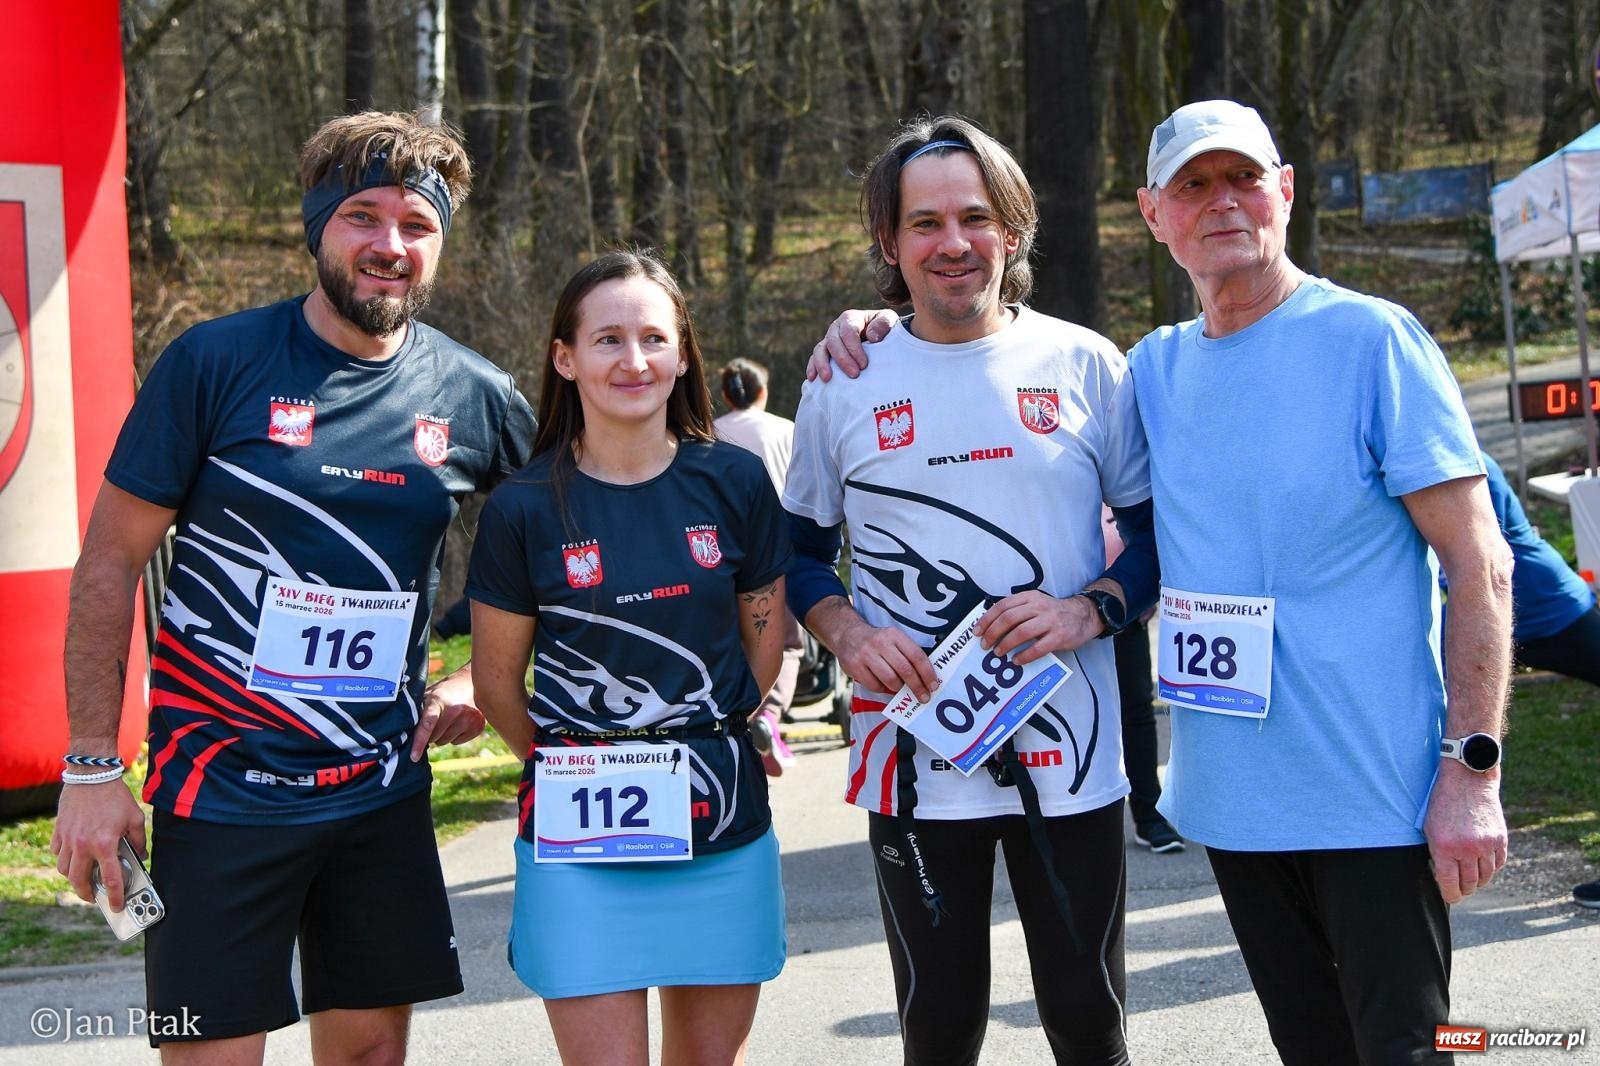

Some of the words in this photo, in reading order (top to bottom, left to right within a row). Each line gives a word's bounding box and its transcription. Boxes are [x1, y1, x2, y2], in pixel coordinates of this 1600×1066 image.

[270, 396, 315, 407] POLSKA
[873, 398, 912, 413] POLSKA
[561, 538, 598, 550] POLSKA
[277, 586, 301, 600] XIV
[305, 591, 336, 607] BIEG
[341, 596, 406, 610] TWARDZIELA
[1175, 597, 1191, 612] BIEG
[1194, 600, 1263, 616] TWARDZIELA
[285, 603, 312, 612] marzec
[313, 606, 333, 616] 2026
[301, 625, 376, 671] 116
[1174, 631, 1237, 680] 128
[935, 651, 1024, 733] 048
[895, 692, 913, 713] XIV
[904, 711, 913, 719] 15
[545, 754, 564, 766] XIV
[568, 754, 596, 766] BIEG
[600, 752, 676, 765] TWARDZIEL
[571, 785, 649, 829] 112
[625, 843, 654, 851] Racibórz
